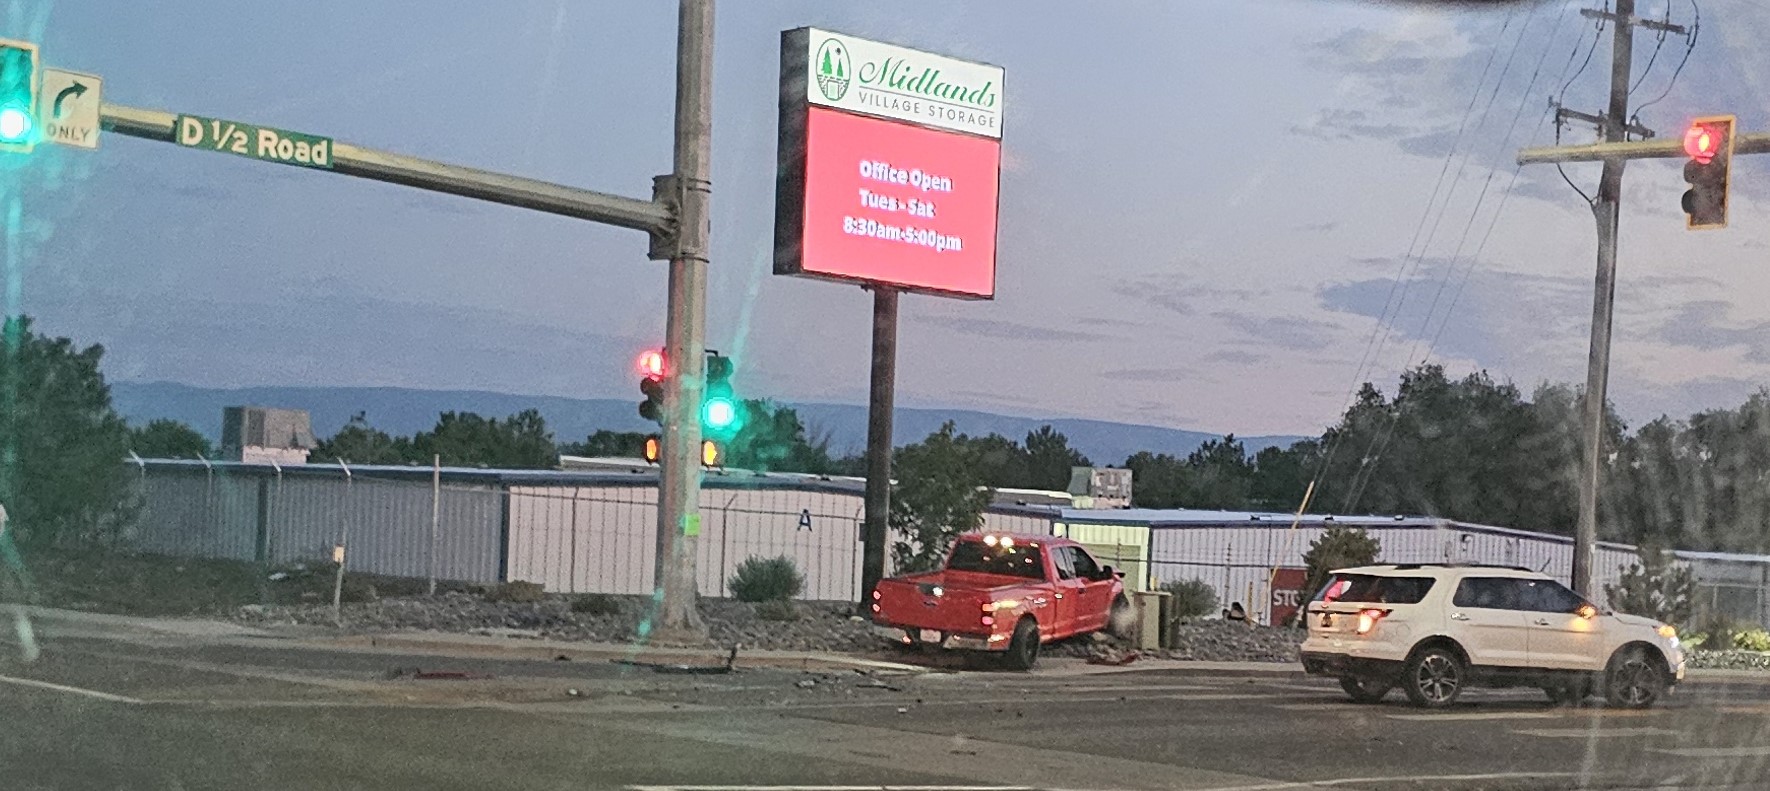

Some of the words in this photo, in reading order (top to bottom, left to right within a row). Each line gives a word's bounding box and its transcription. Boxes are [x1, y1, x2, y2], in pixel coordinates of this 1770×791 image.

[859, 56, 996, 107] Midlands
[859, 91, 921, 114] VILLAGE
[929, 106, 995, 128] STORAGE
[46, 122, 91, 142] ONLY
[181, 118, 203, 146] D
[257, 130, 328, 166] Road
[859, 160, 908, 185] Office
[909, 169, 952, 192] Open
[859, 188, 898, 211] Tues
[907, 198, 936, 218] Sat
[843, 216, 962, 252] 8:30am-5:00pm
[797, 508, 812, 532] A
